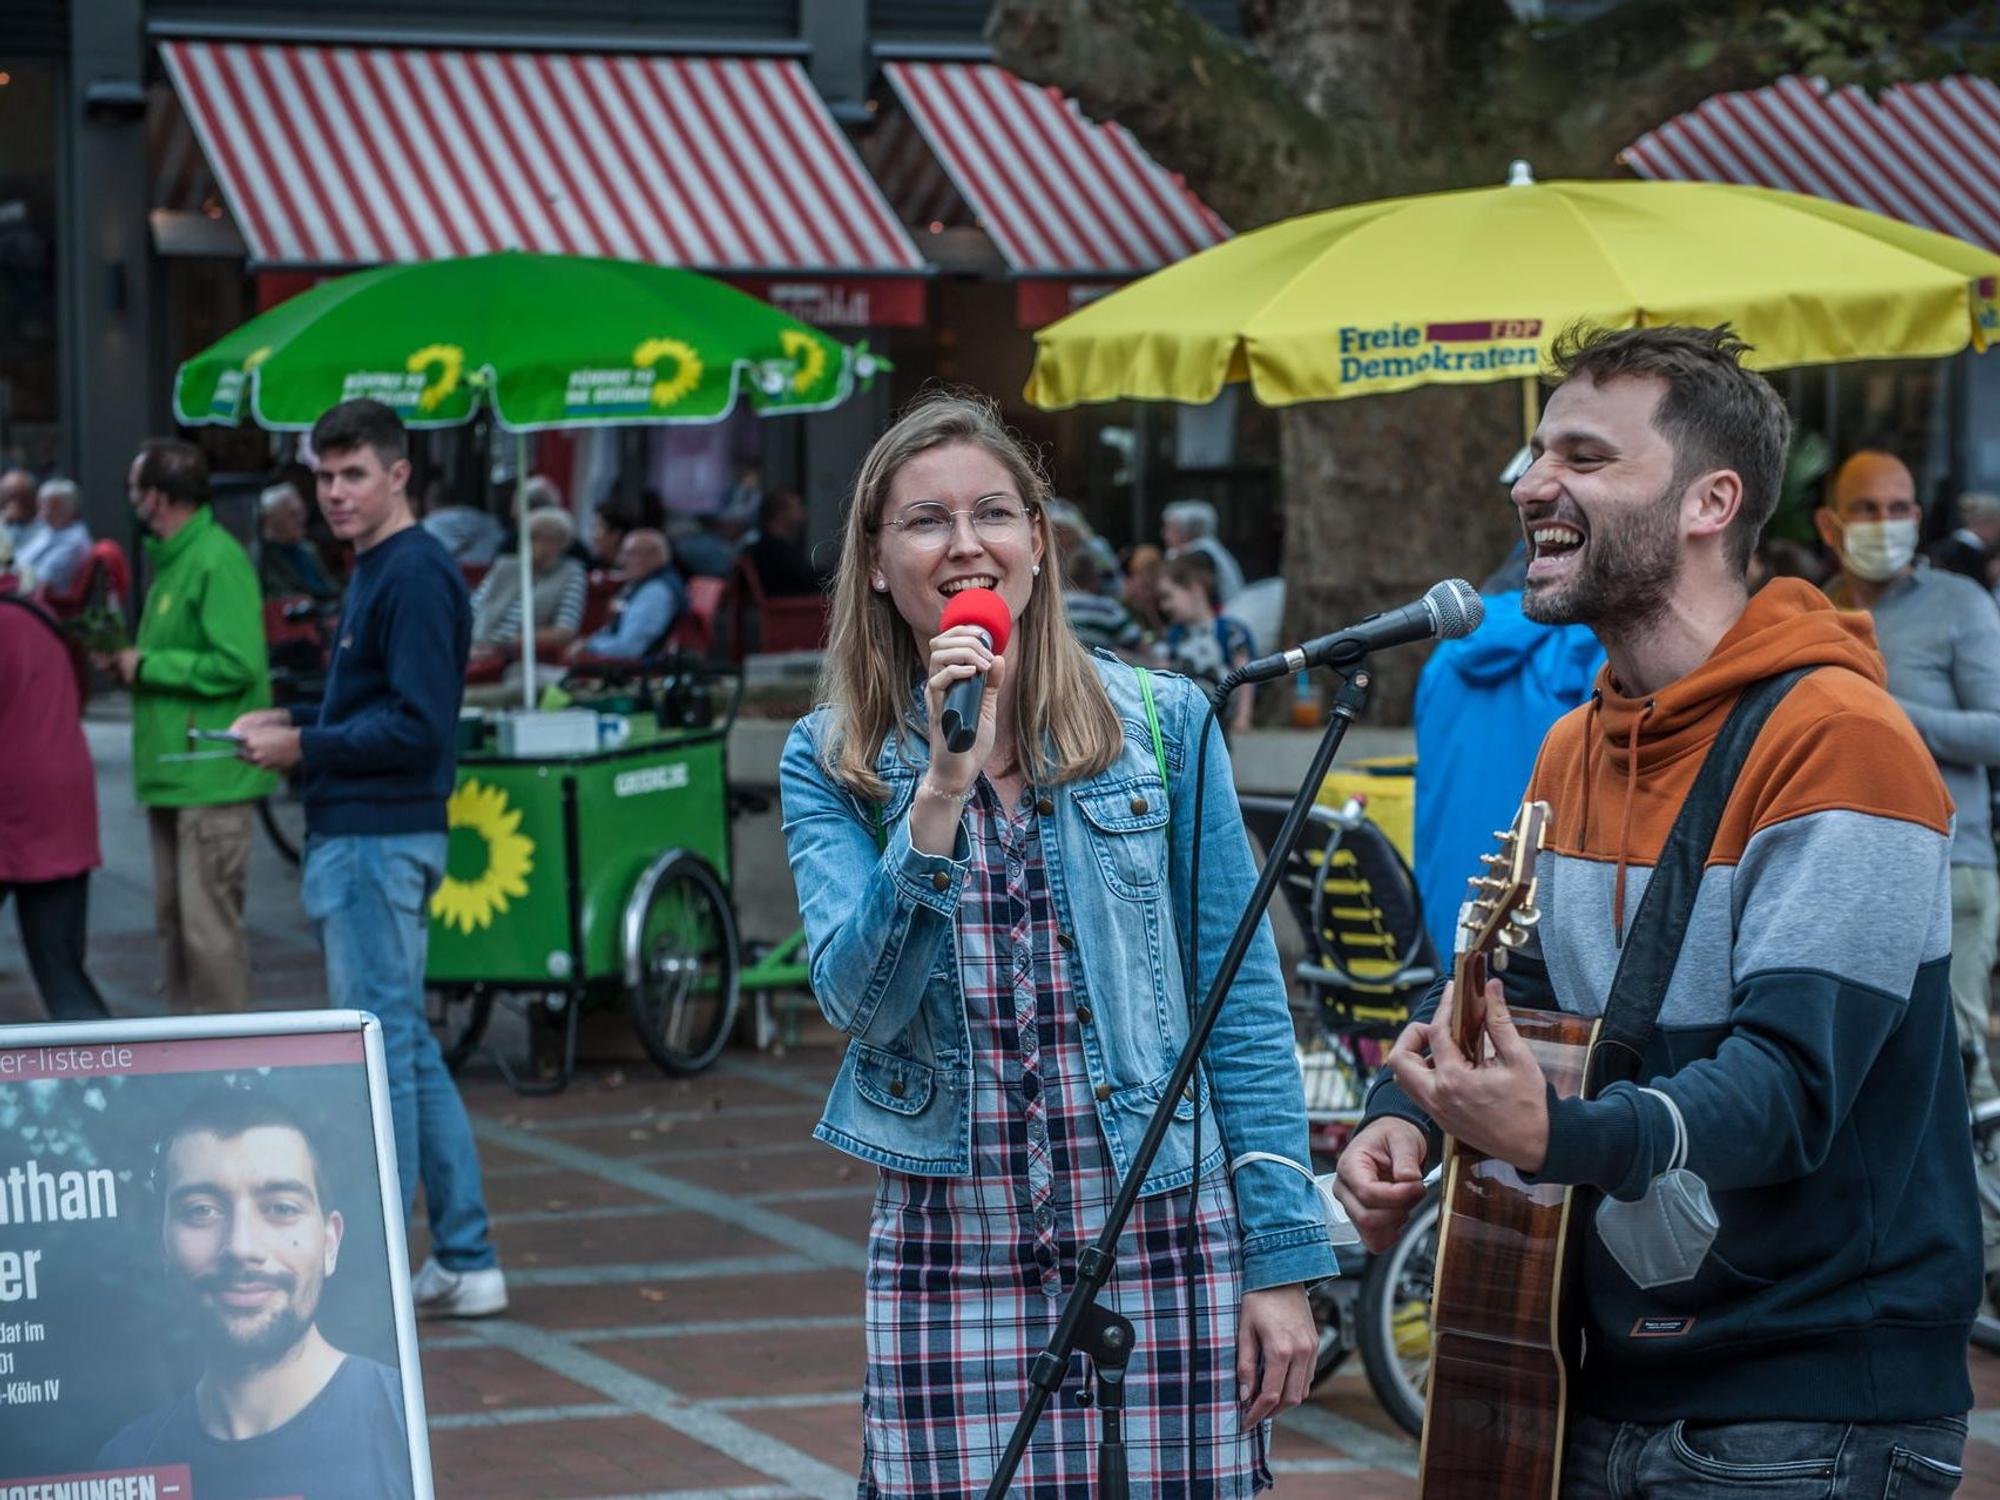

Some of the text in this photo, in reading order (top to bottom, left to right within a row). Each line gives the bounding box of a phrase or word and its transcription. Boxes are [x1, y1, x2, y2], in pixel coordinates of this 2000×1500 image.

[1339, 322, 1421, 354] Freie
[1340, 344, 1538, 383] Demokraten
[0, 1044, 133, 1073] er-liste.de
[0, 1249, 42, 1301] er
[24, 1320, 45, 1342] im
[0, 1379, 60, 1405] -Köln IV
[0, 1474, 156, 1500] OFFNUNGEN
